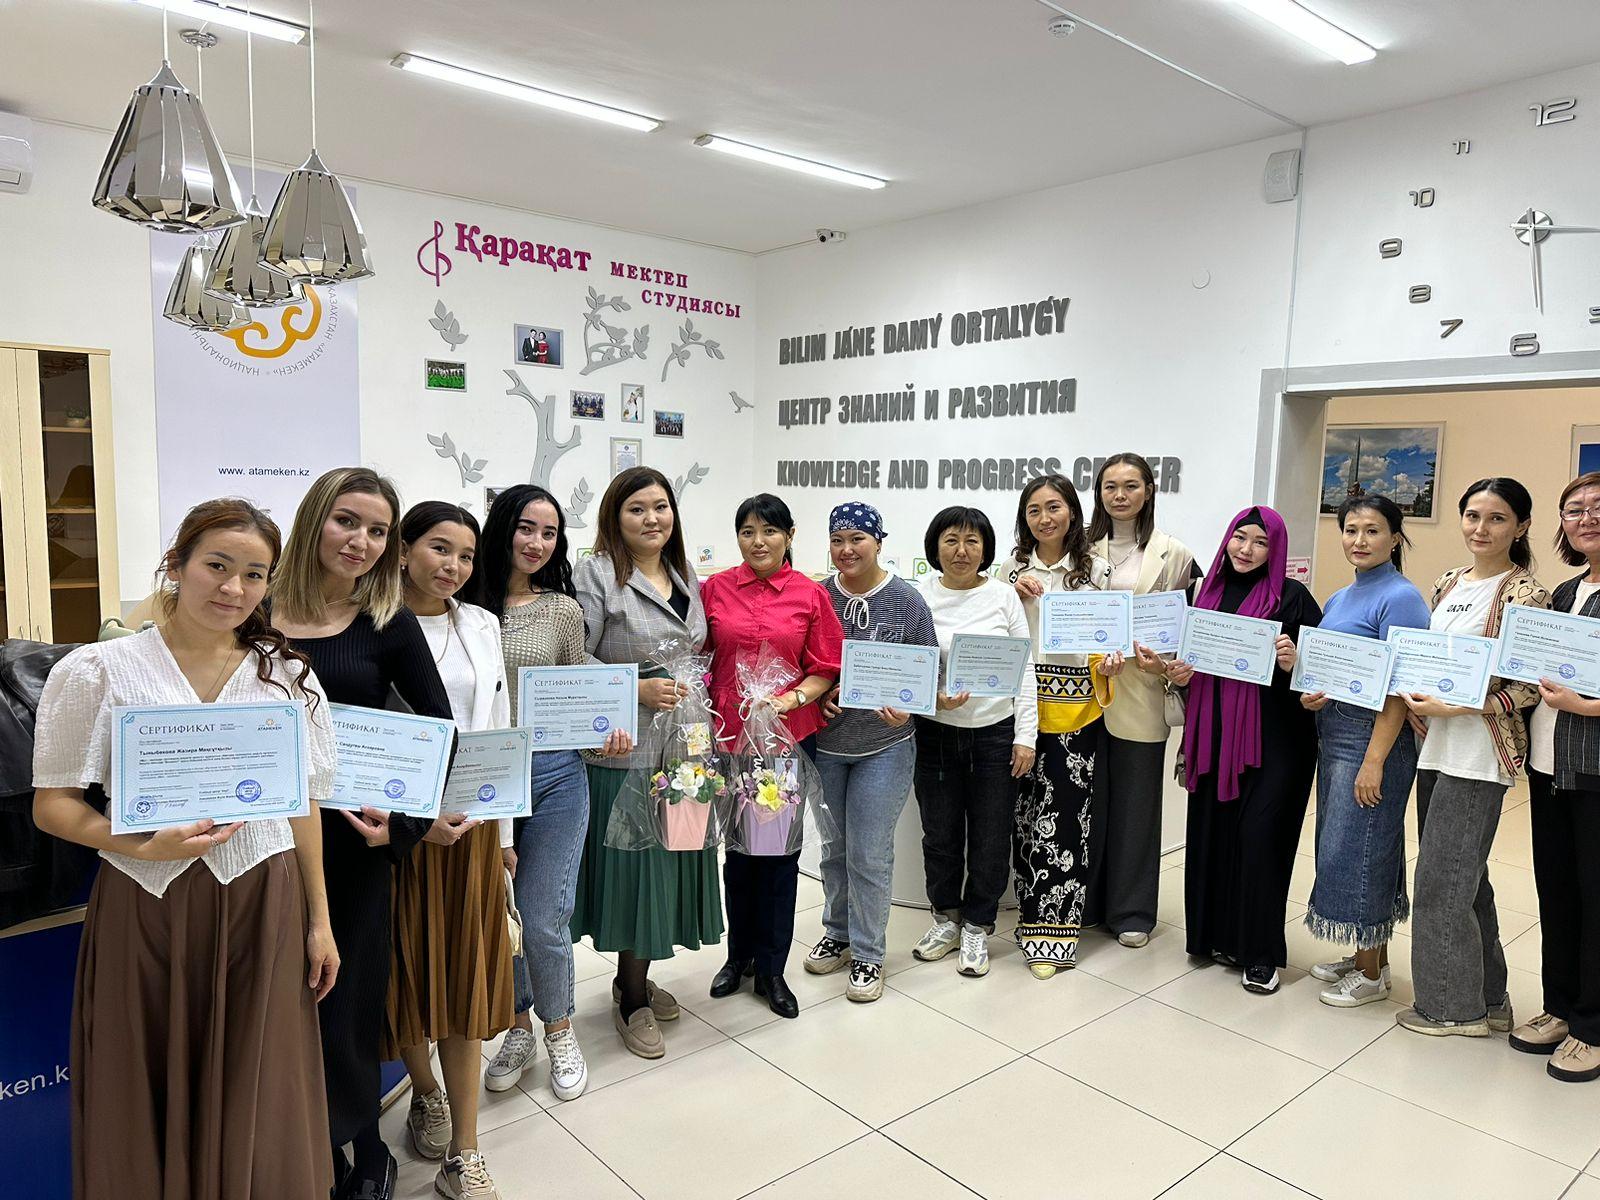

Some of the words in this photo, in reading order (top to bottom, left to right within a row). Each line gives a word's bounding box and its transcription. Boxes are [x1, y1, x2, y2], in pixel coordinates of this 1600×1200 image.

[1529, 97, 1576, 127] 12
[1452, 139, 1470, 155] 11
[1408, 187, 1435, 208] 10
[454, 222, 592, 272] Қарақат
[1379, 238, 1402, 259] 9
[610, 260, 688, 289] МЕКТЕП
[641, 288, 741, 319] СТУДИЯСЫ
[1408, 284, 1431, 303] 8
[1440, 318, 1463, 338] 7
[779, 333, 826, 365] BILIM
[1509, 333, 1539, 356] 6
[778, 398, 832, 429] ЦЕНТР
[838, 383, 916, 424] ЗНАНИЙ
[924, 390, 940, 420] И
[947, 379, 1077, 420] РАЗВИТИЯ
[218, 467, 246, 475] www.
[248, 467, 310, 477] atameken.kz
[777, 460, 880, 488] KNOWLEDGE
[888, 459, 929, 489] AND
[139, 723, 216, 735] СЕРТИФИКАТ
